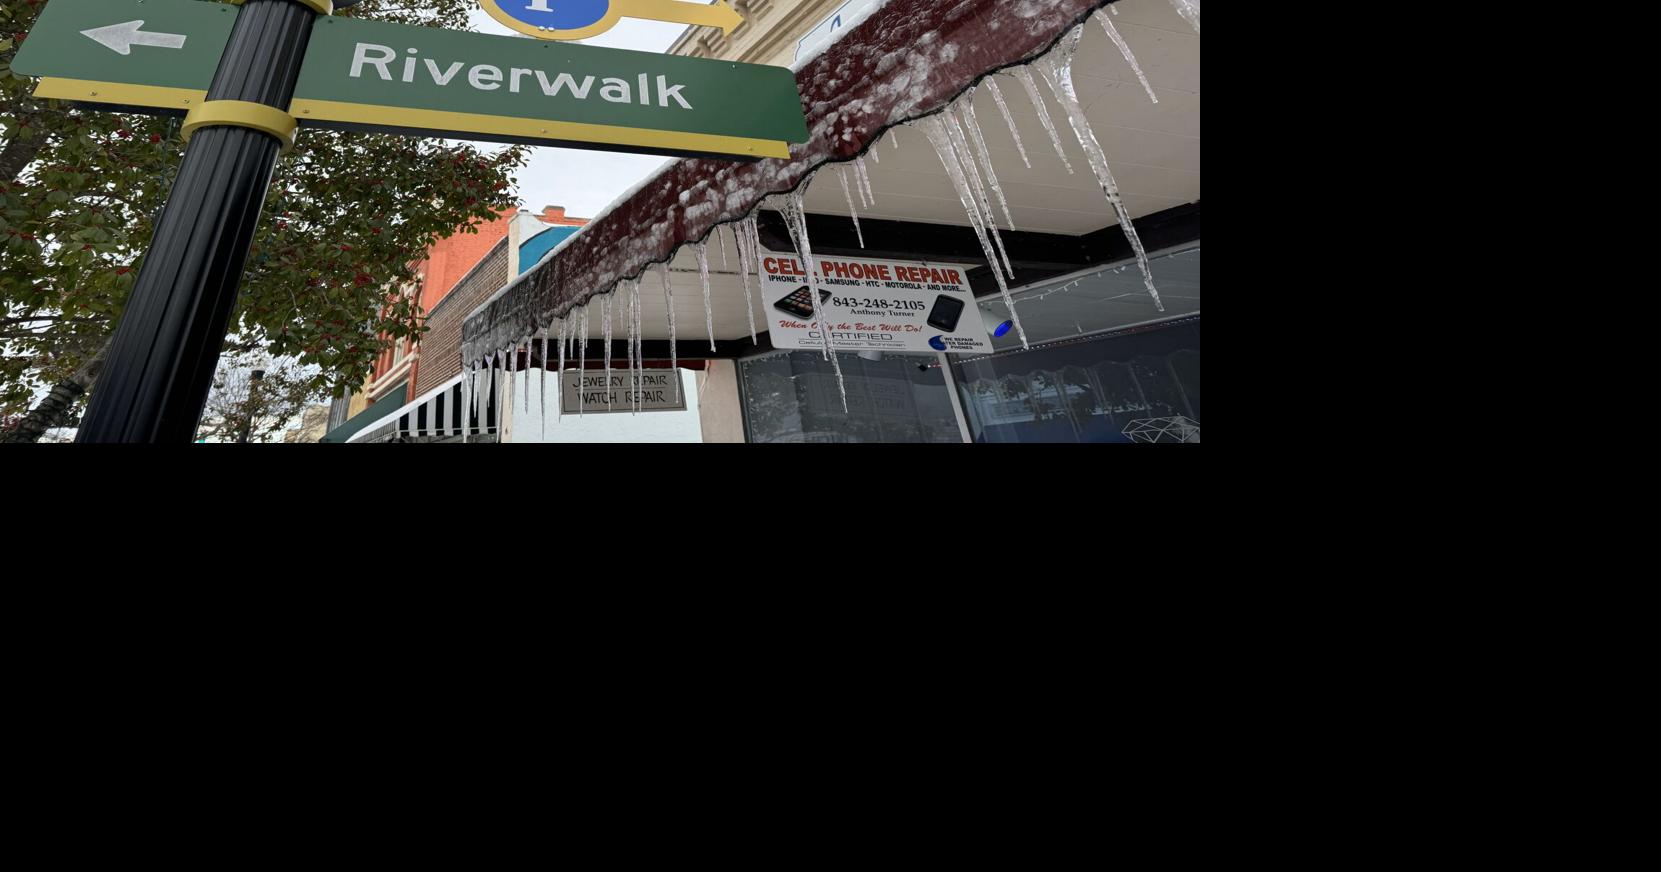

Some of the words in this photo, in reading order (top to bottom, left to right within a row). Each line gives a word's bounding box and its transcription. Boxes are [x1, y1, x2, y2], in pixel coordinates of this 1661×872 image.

[349, 42, 693, 110] Riverwalk
[763, 257, 818, 276] CEL
[820, 260, 892, 281] PHONE
[894, 265, 963, 285] REPAIR
[768, 275, 797, 283] IPHONE
[824, 278, 860, 286] SAMSUNG
[884, 282, 922, 290] MOTOROLA
[832, 296, 926, 311] 843-248-2105
[850, 308, 886, 318] Anthony
[779, 320, 807, 329] When
[837, 322, 851, 330] the
[855, 322, 876, 331] Best
[879, 324, 902, 332] Will
[904, 324, 922, 333] Do!
[808, 332, 892, 340] CRTIFIED
[572, 376, 624, 387] JEWELRY
[577, 392, 617, 404] WATCH
[625, 390, 666, 403] REPAIR
